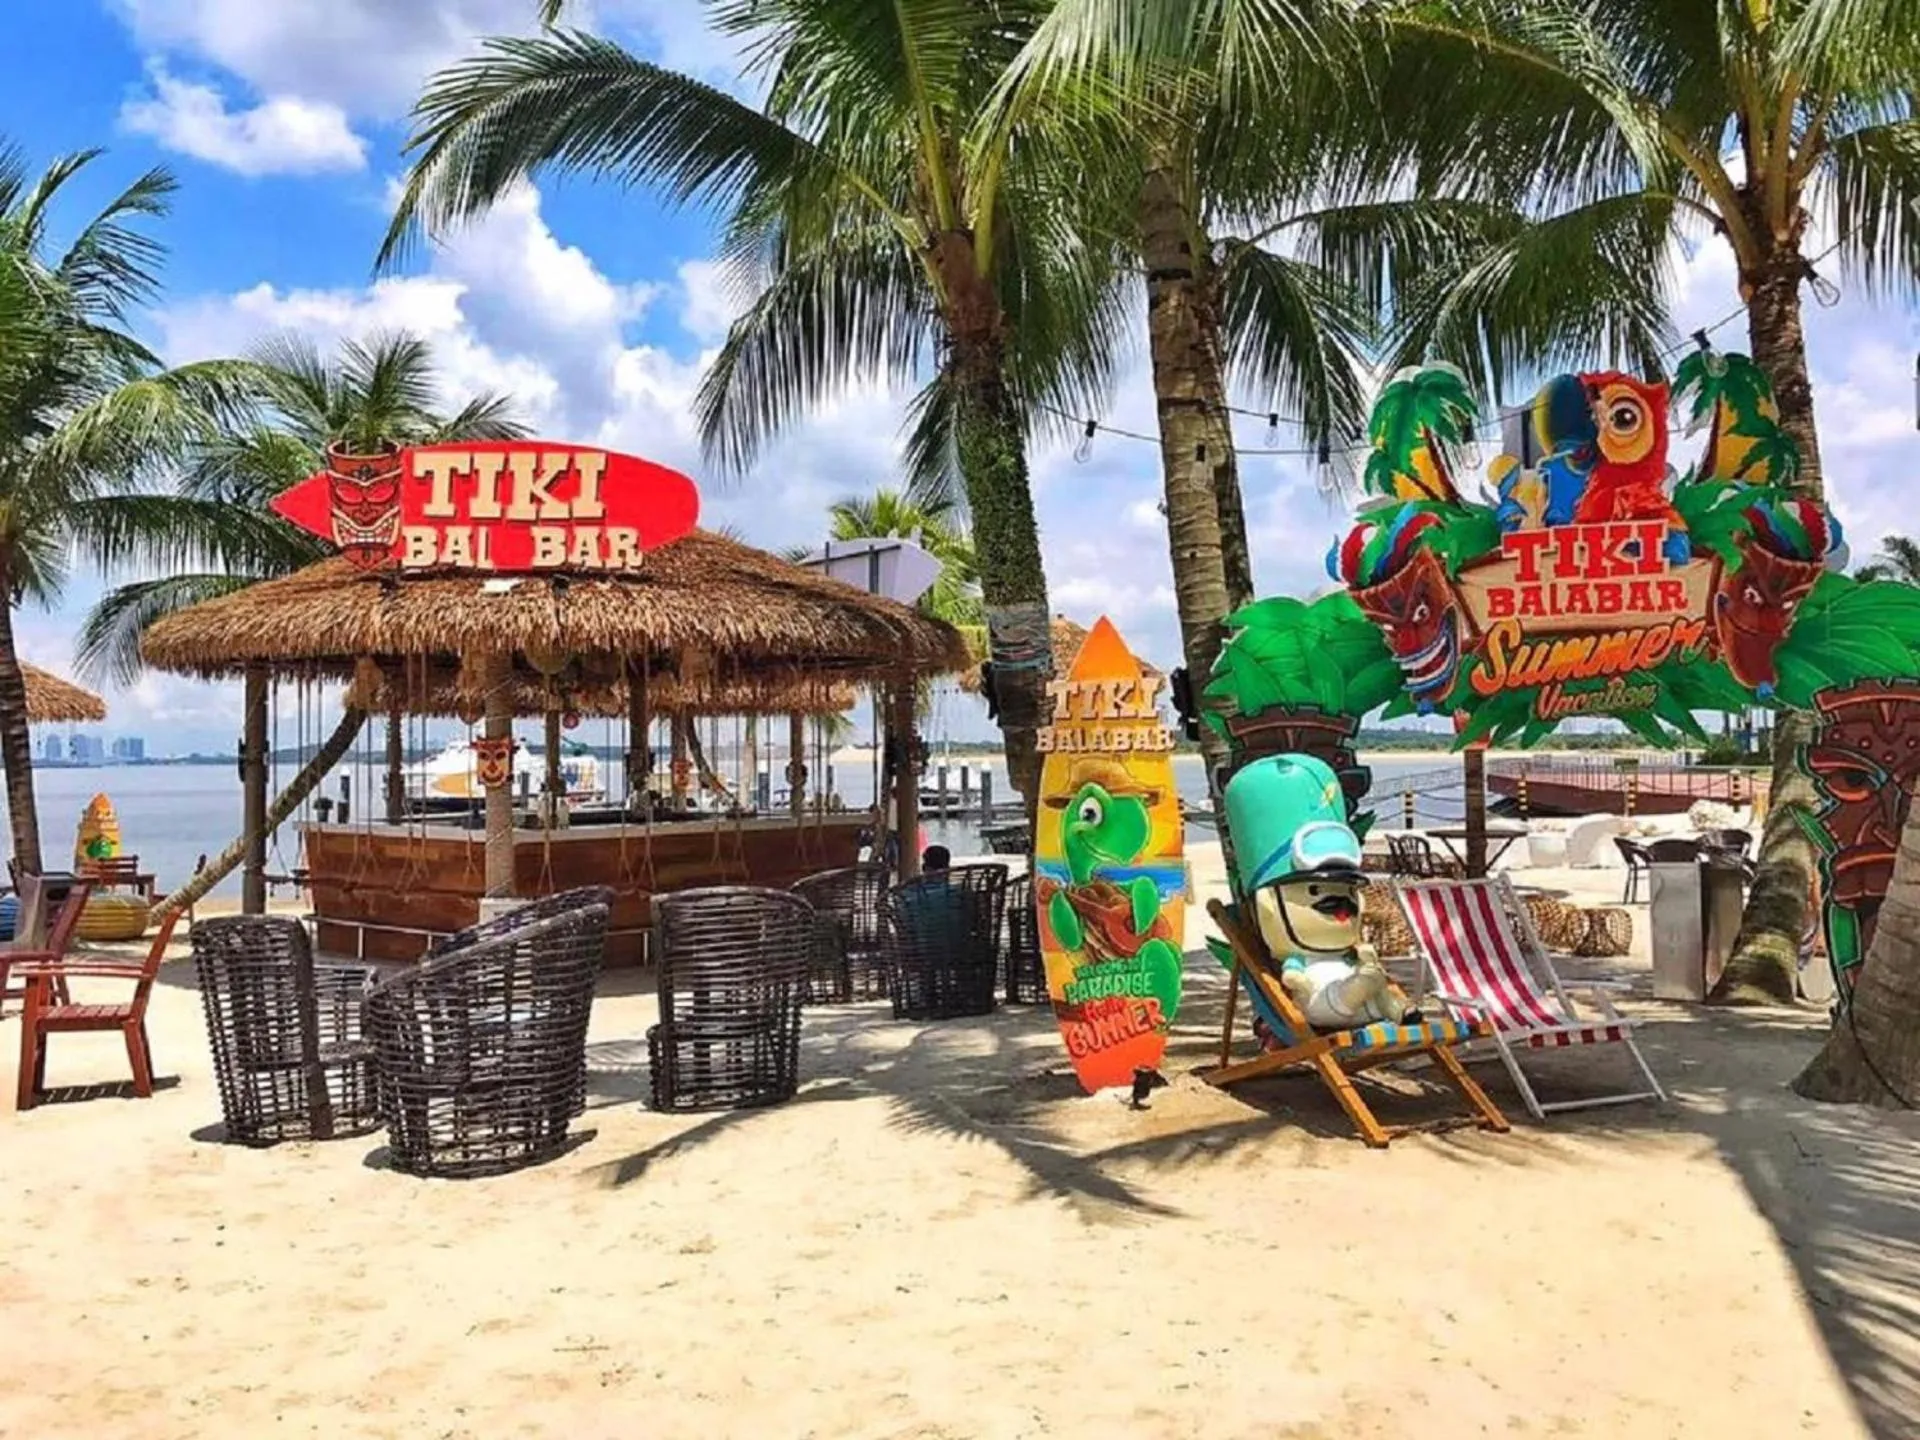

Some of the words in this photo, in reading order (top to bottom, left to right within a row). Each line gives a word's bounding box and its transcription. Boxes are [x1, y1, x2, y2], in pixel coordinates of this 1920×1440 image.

[414, 452, 607, 520] TIKI
[531, 526, 643, 569] BAR
[1502, 520, 1668, 582] TIKI
[1046, 678, 1161, 719] TIKI
[1065, 972, 1155, 1004] PARADISE
